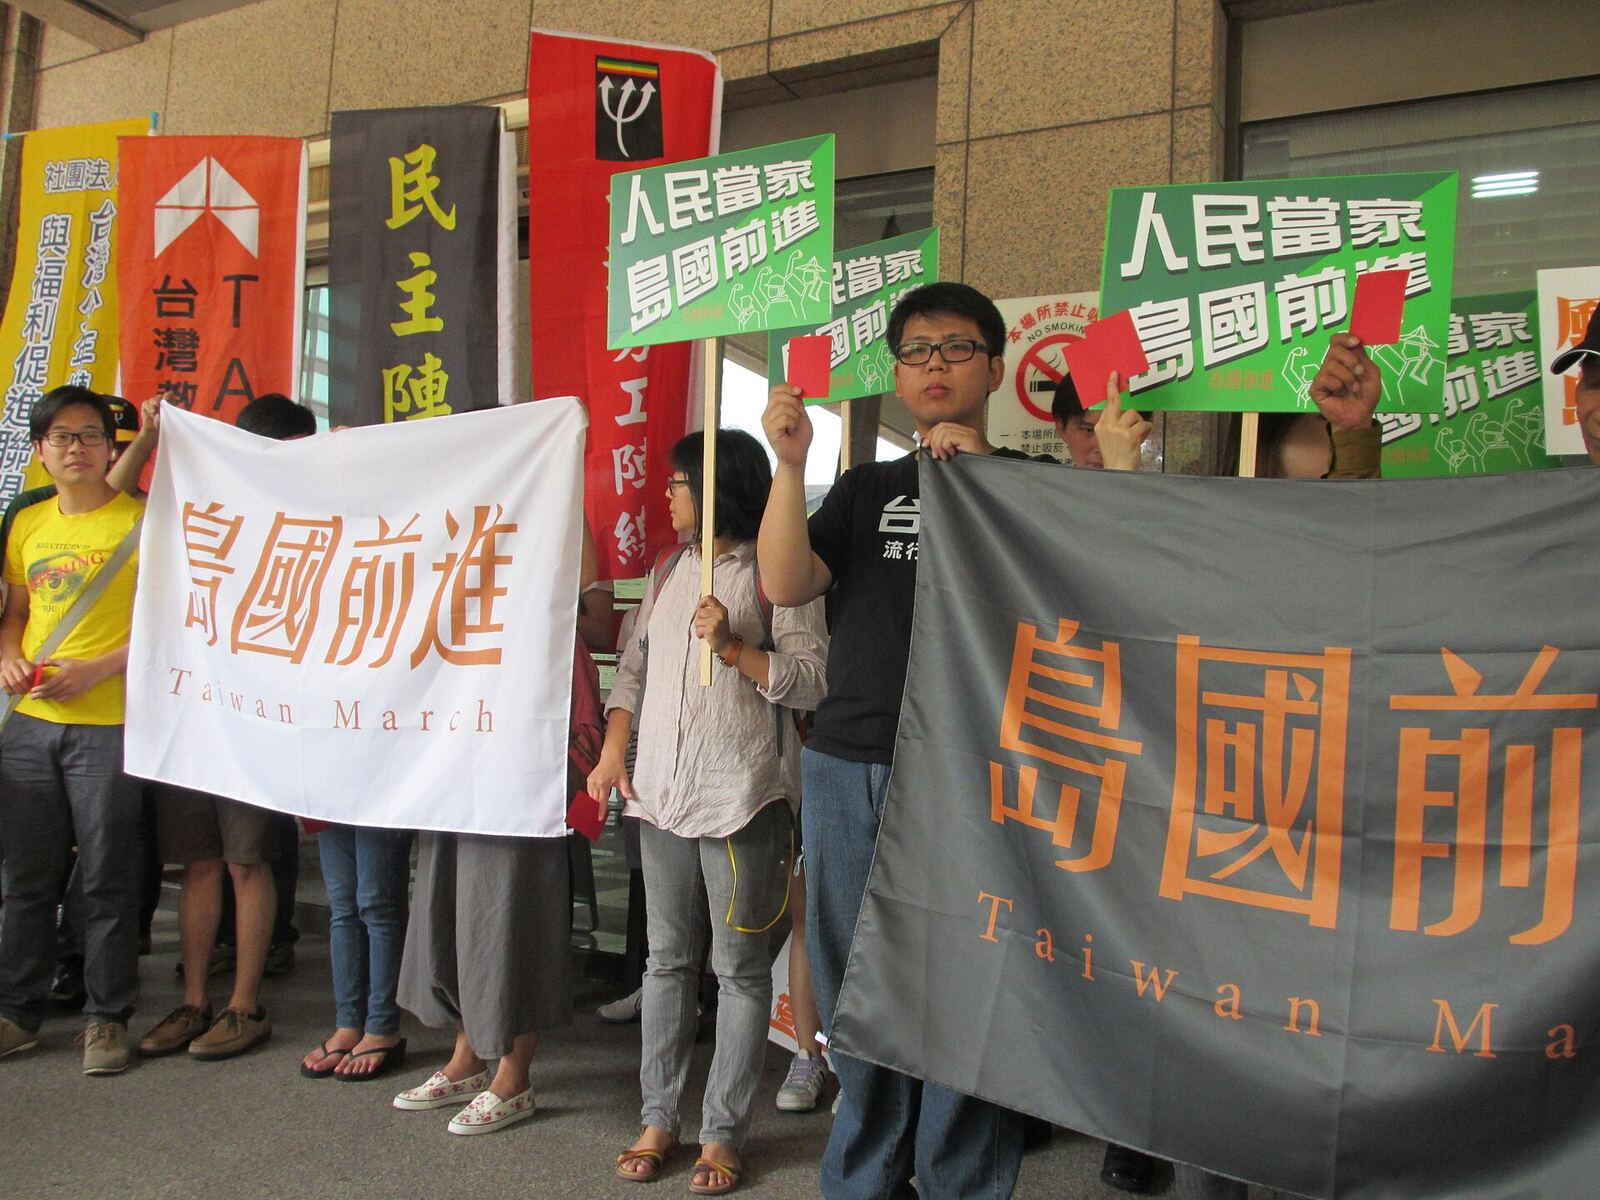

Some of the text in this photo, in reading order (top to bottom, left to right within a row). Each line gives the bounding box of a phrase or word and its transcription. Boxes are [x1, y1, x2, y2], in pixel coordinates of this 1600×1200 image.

[620, 160, 816, 245] 人民當家
[1120, 191, 1427, 279] 人民當家
[626, 200, 820, 334] 島國前進
[1027, 329, 1043, 342] NO
[182, 501, 518, 670] 島國前進
[168, 667, 494, 733] Taiwan March
[989, 618, 1598, 946] 島國前
[977, 891, 1323, 1037] Taiwan
